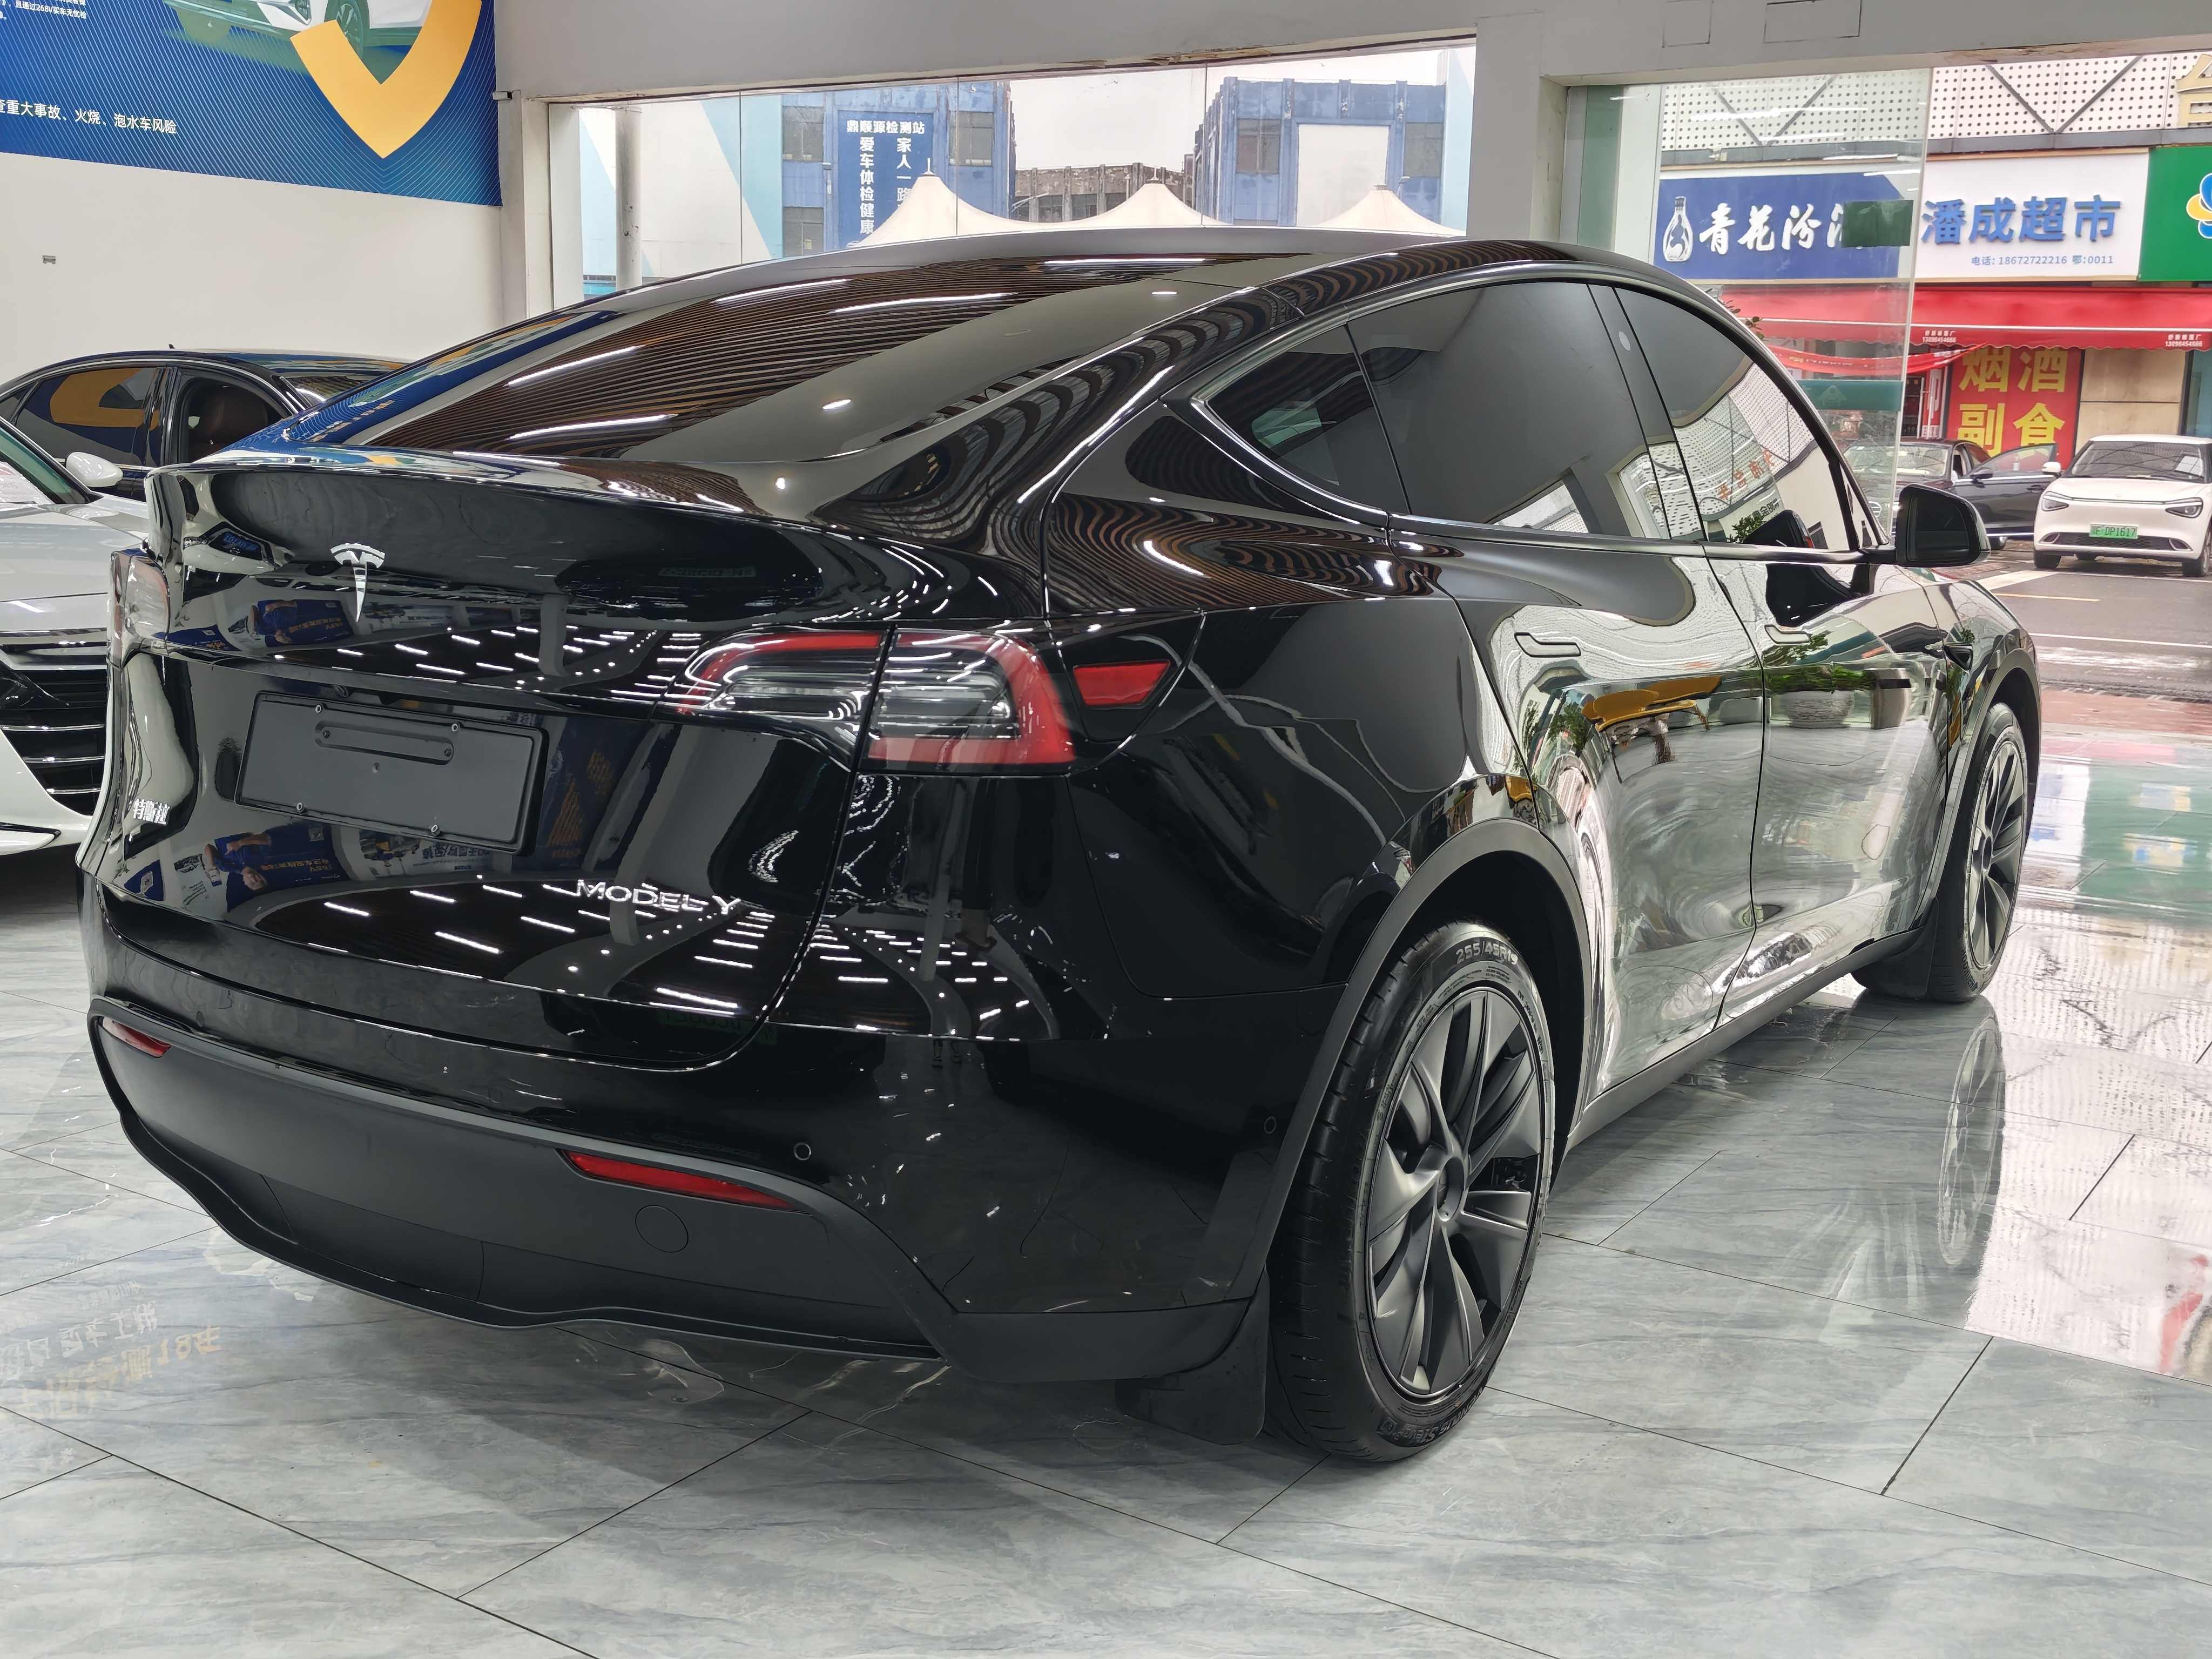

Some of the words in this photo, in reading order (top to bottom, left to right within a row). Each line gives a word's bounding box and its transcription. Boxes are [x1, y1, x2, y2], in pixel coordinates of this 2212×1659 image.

[846, 120, 925, 134] 鼎顺源检测站
[859, 137, 874, 234] 爱车体检健康
[896, 138, 912, 208] 家人一路
[1699, 203, 1844, 255] 青花汾
[1921, 194, 2121, 245] 潘成超市
[1959, 346, 2068, 393] 烟酒
[133, 799, 170, 825] 特斯拉
[576, 879, 704, 912] MODEL
[712, 894, 741, 915] Y
[1455, 940, 1519, 966] 255/45R19
